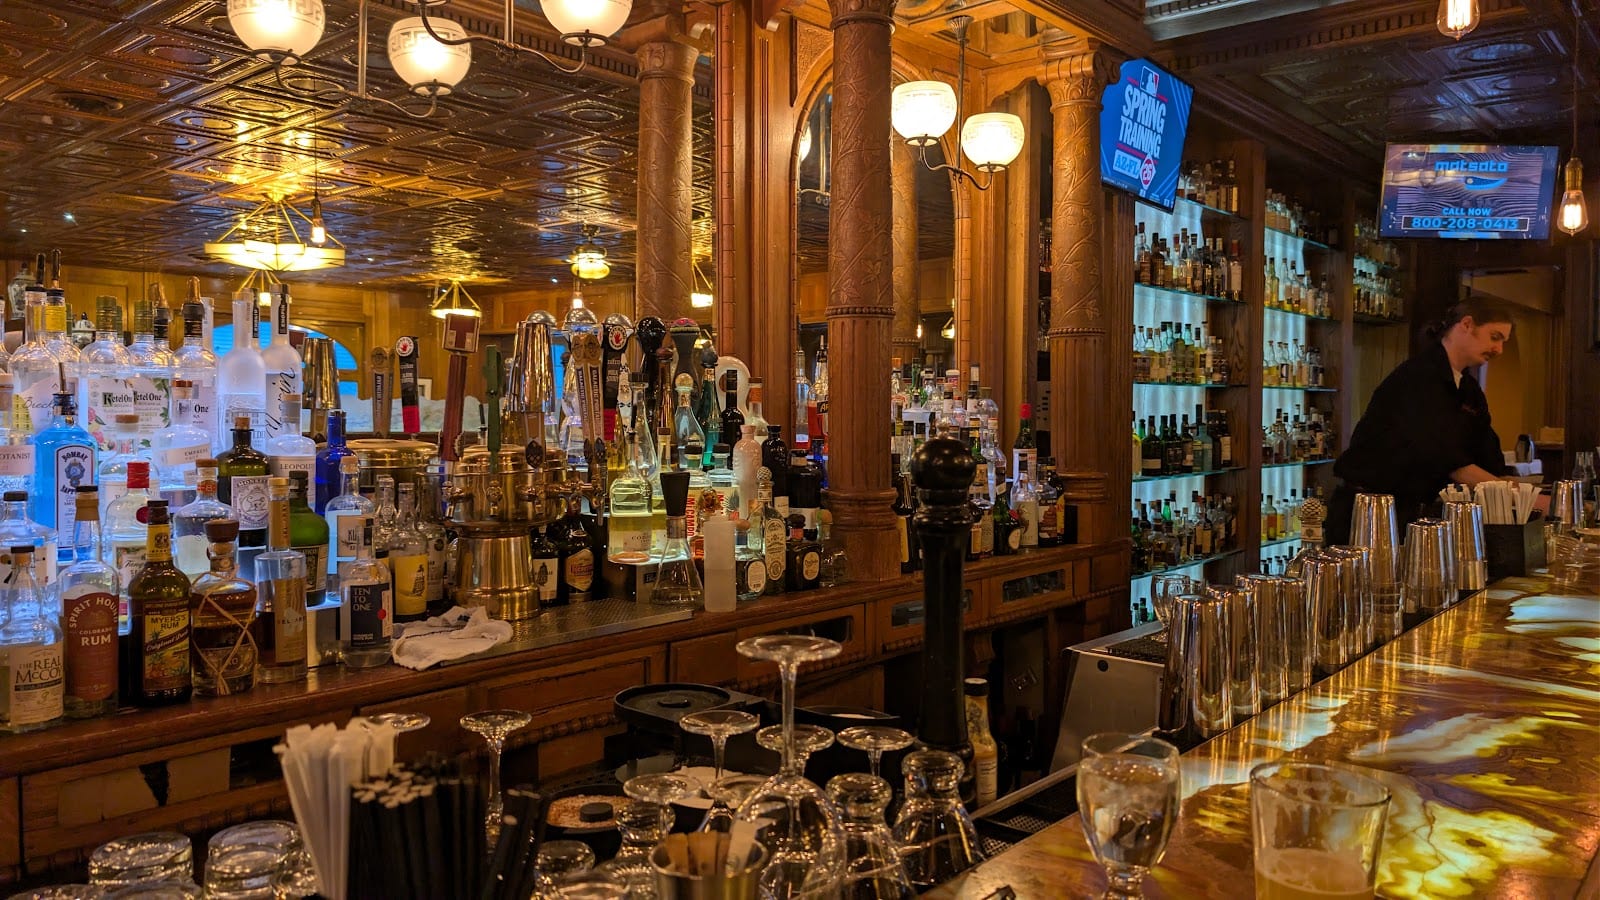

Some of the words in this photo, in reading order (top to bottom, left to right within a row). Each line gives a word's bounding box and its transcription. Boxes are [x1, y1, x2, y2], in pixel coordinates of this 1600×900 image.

[1122, 84, 1166, 134] SPRING
[1118, 115, 1162, 160] TRAINING
[1434, 160, 1509, 173] matsato
[1442, 207, 1466, 216] CALL
[1467, 207, 1492, 217] NOW
[1411, 217, 1520, 230] 800-208-0413
[194, 404, 209, 413] One
[0, 453, 30, 461] OTANIST
[61, 451, 88, 463] BOMBAY
[354, 588, 371, 596] TEN
[354, 596, 366, 604] TO
[353, 603, 374, 611] ONE
[69, 600, 91, 628] SPIRIT
[160, 621, 179, 629] RUM
[81, 634, 111, 646] RUM
[33, 656, 61, 671] REAL
